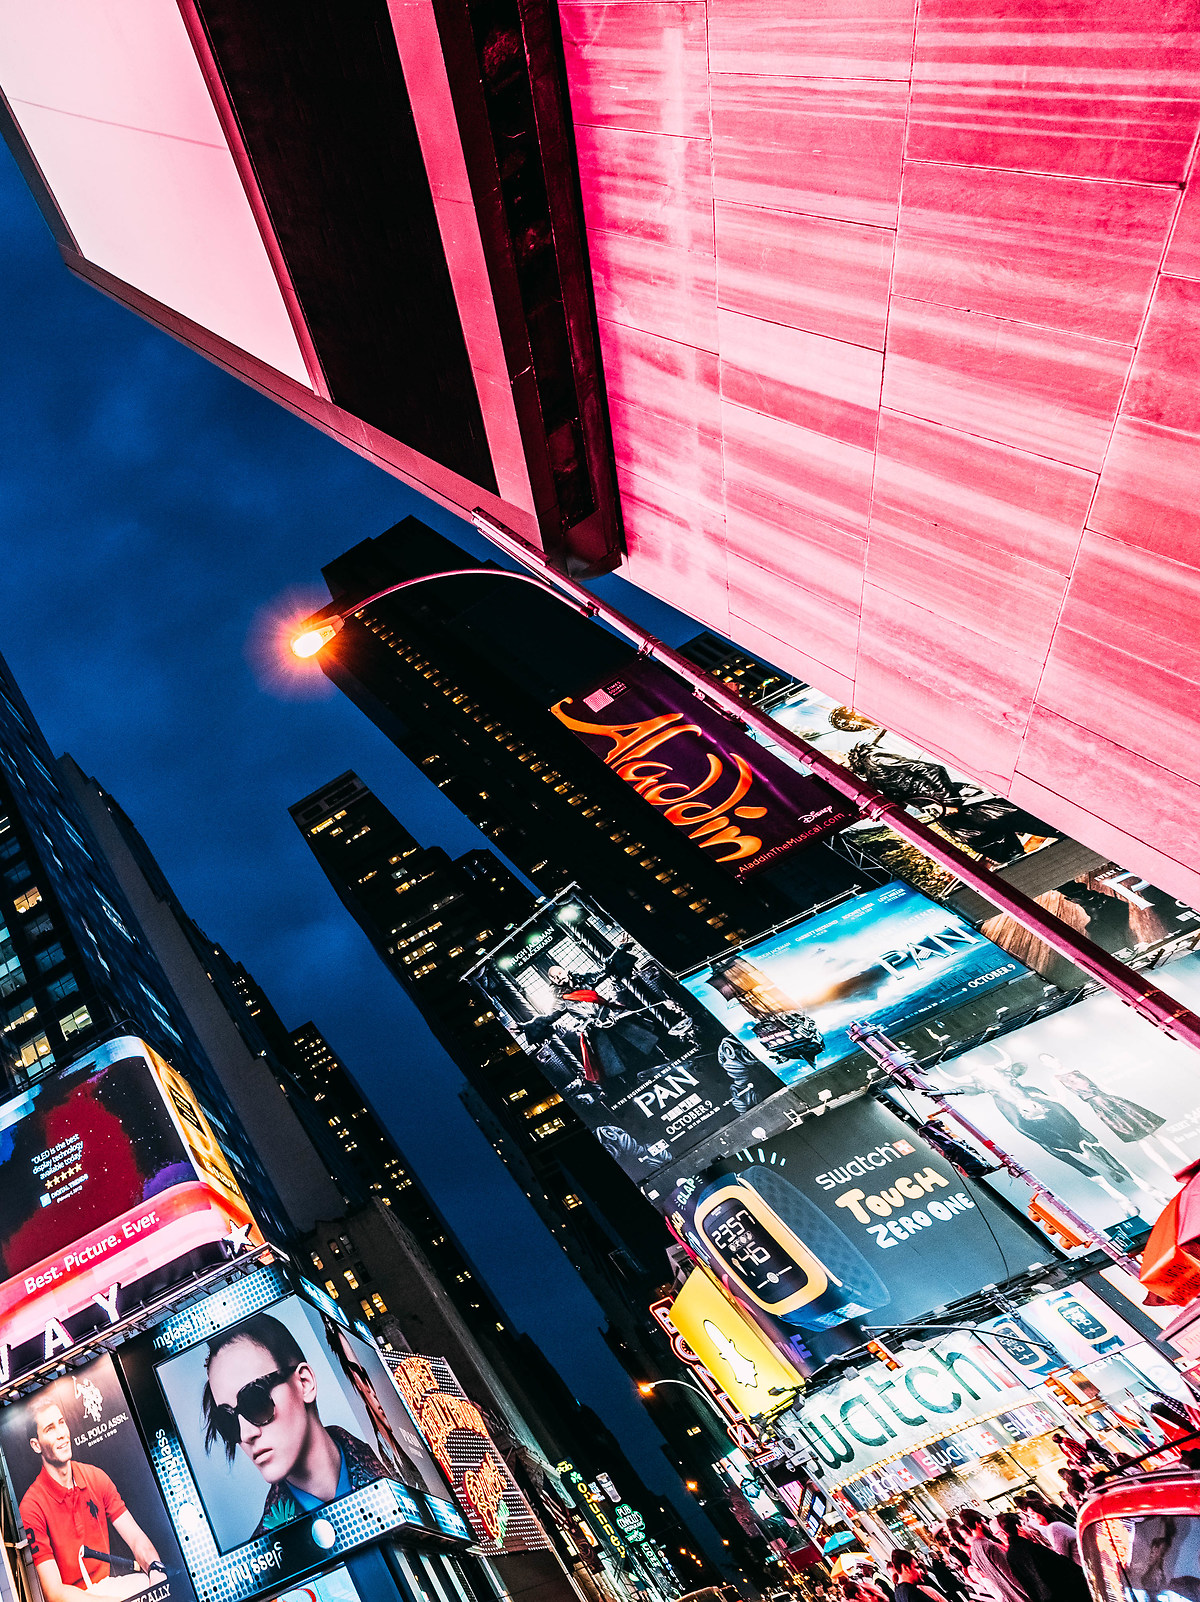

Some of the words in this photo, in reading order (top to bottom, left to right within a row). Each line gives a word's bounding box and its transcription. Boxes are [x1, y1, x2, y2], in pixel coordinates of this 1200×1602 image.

[738, 812, 846, 873] AladdinTheMusical.com
[877, 925, 982, 980] PAN
[967, 966, 1011, 988] OCTOBER
[1008, 963, 1016, 972] 9
[633, 1065, 700, 1118] PAN
[666, 1103, 705, 1135] OCTOBER
[704, 1099, 713, 1109] 9
[32, 1159, 52, 1174] display
[52, 1140, 84, 1163] technology
[49, 1147, 56, 1155] is
[55, 1141, 66, 1151] the
[65, 1133, 80, 1145] best
[40, 1161, 65, 1180] available
[815, 1142, 902, 1191] swatch
[676, 1178, 697, 1205] CLAP
[866, 1210, 932, 1249] ZERO
[927, 1192, 976, 1221] ONE
[24, 1266, 63, 1294] Best.
[63, 1235, 121, 1272] Picture.
[121, 1211, 160, 1239] Ever.
[74, 1434, 88, 1446] U.S.
[87, 1423, 107, 1439] POLO
[108, 1413, 129, 1429] ASSN.
[798, 1347, 1002, 1472] watch
